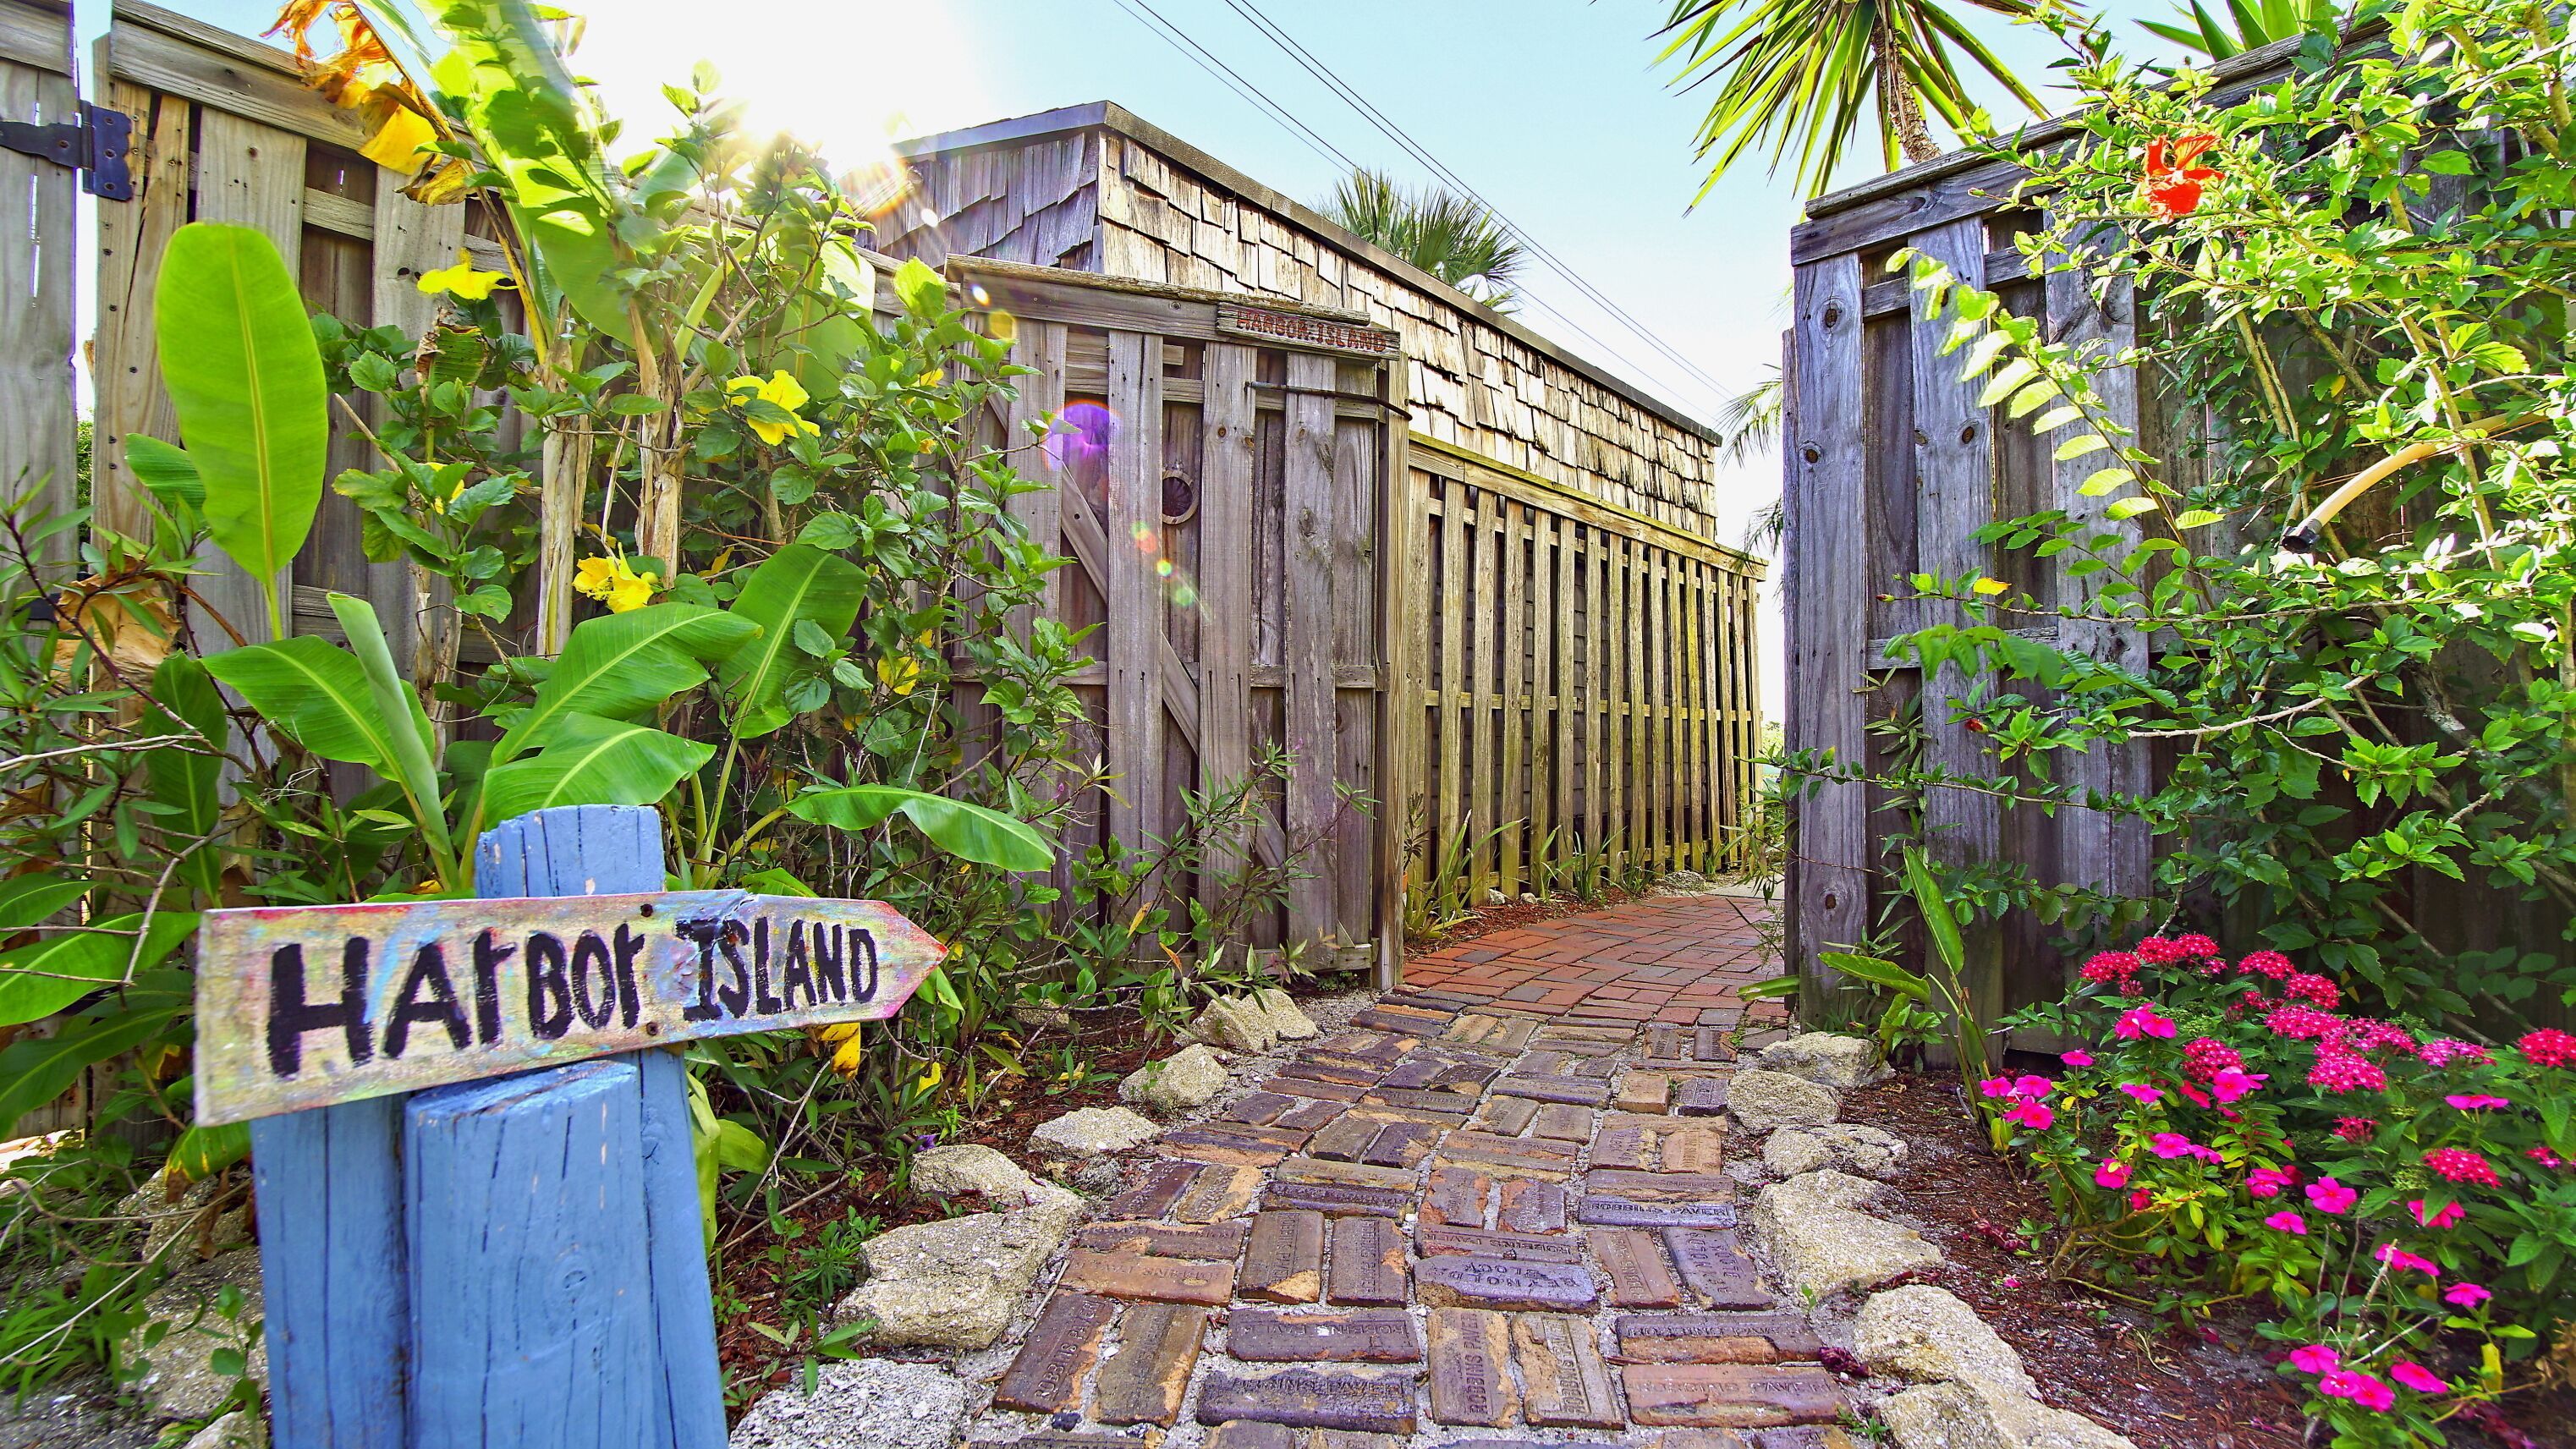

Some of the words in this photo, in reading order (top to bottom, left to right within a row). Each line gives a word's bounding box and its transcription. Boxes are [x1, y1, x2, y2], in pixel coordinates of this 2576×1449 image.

[1236, 310, 1309, 340] HARBOR
[1316, 322, 1387, 353] ISLAND
[675, 916, 879, 1023] ISLAND
[1590, 1203, 1664, 1214] ROBBINS
[1671, 1205, 1728, 1216] PAVER
[1422, 1233, 1482, 1245] PAVER
[1489, 1239, 1571, 1255] ROBBINS
[1463, 1261, 1538, 1280] BLOCK
[1709, 1245, 1741, 1279] BLOCK
[1034, 1342, 1079, 1402] ROBBINS
[1067, 1299, 1100, 1342] PAVER
[1461, 1313, 1481, 1351] PAVER
[1465, 1354, 1489, 1415] ROBBINS
[1560, 1359, 1586, 1413] ROBBINS
